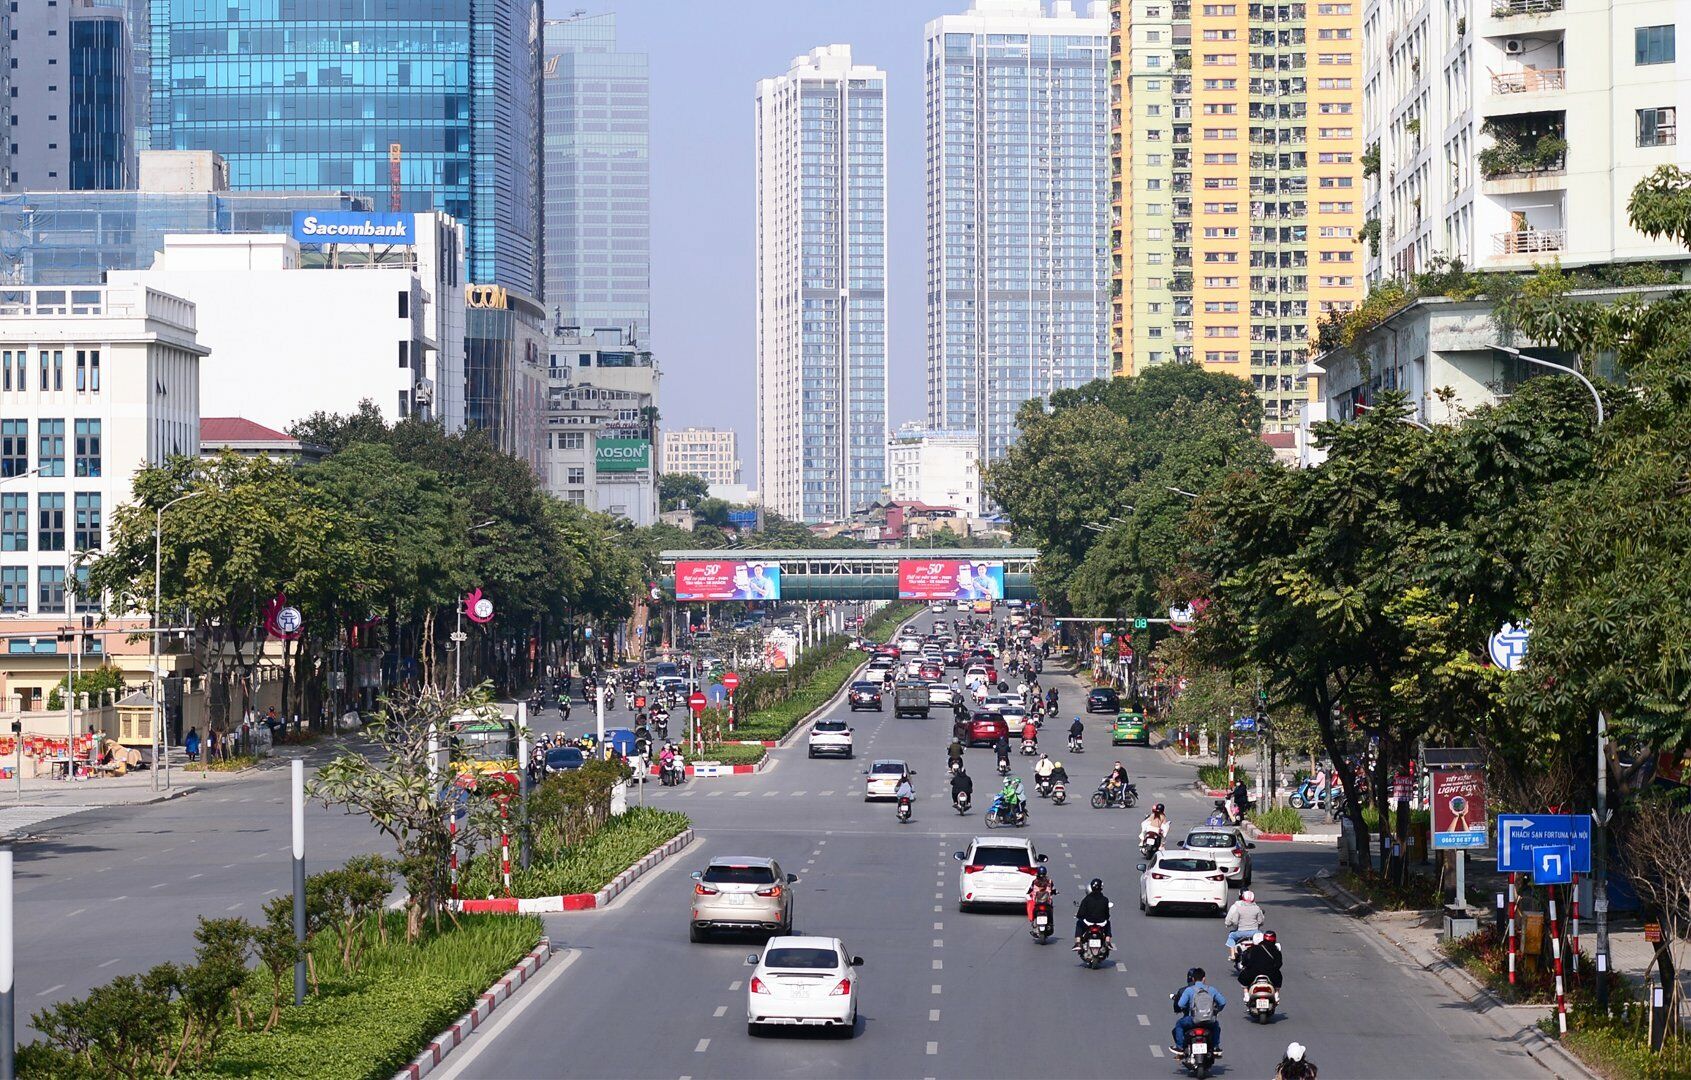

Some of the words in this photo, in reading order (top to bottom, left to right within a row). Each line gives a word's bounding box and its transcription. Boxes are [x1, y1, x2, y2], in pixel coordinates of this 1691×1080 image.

[302, 216, 407, 236] Sacombank
[1134, 618, 1147, 629] 08
[1437, 785, 1461, 795] LIGHT
[1511, 830, 1530, 839] KHÁCH
[1531, 831, 1543, 840] SẠN
[1544, 831, 1569, 839] FORTUNA
